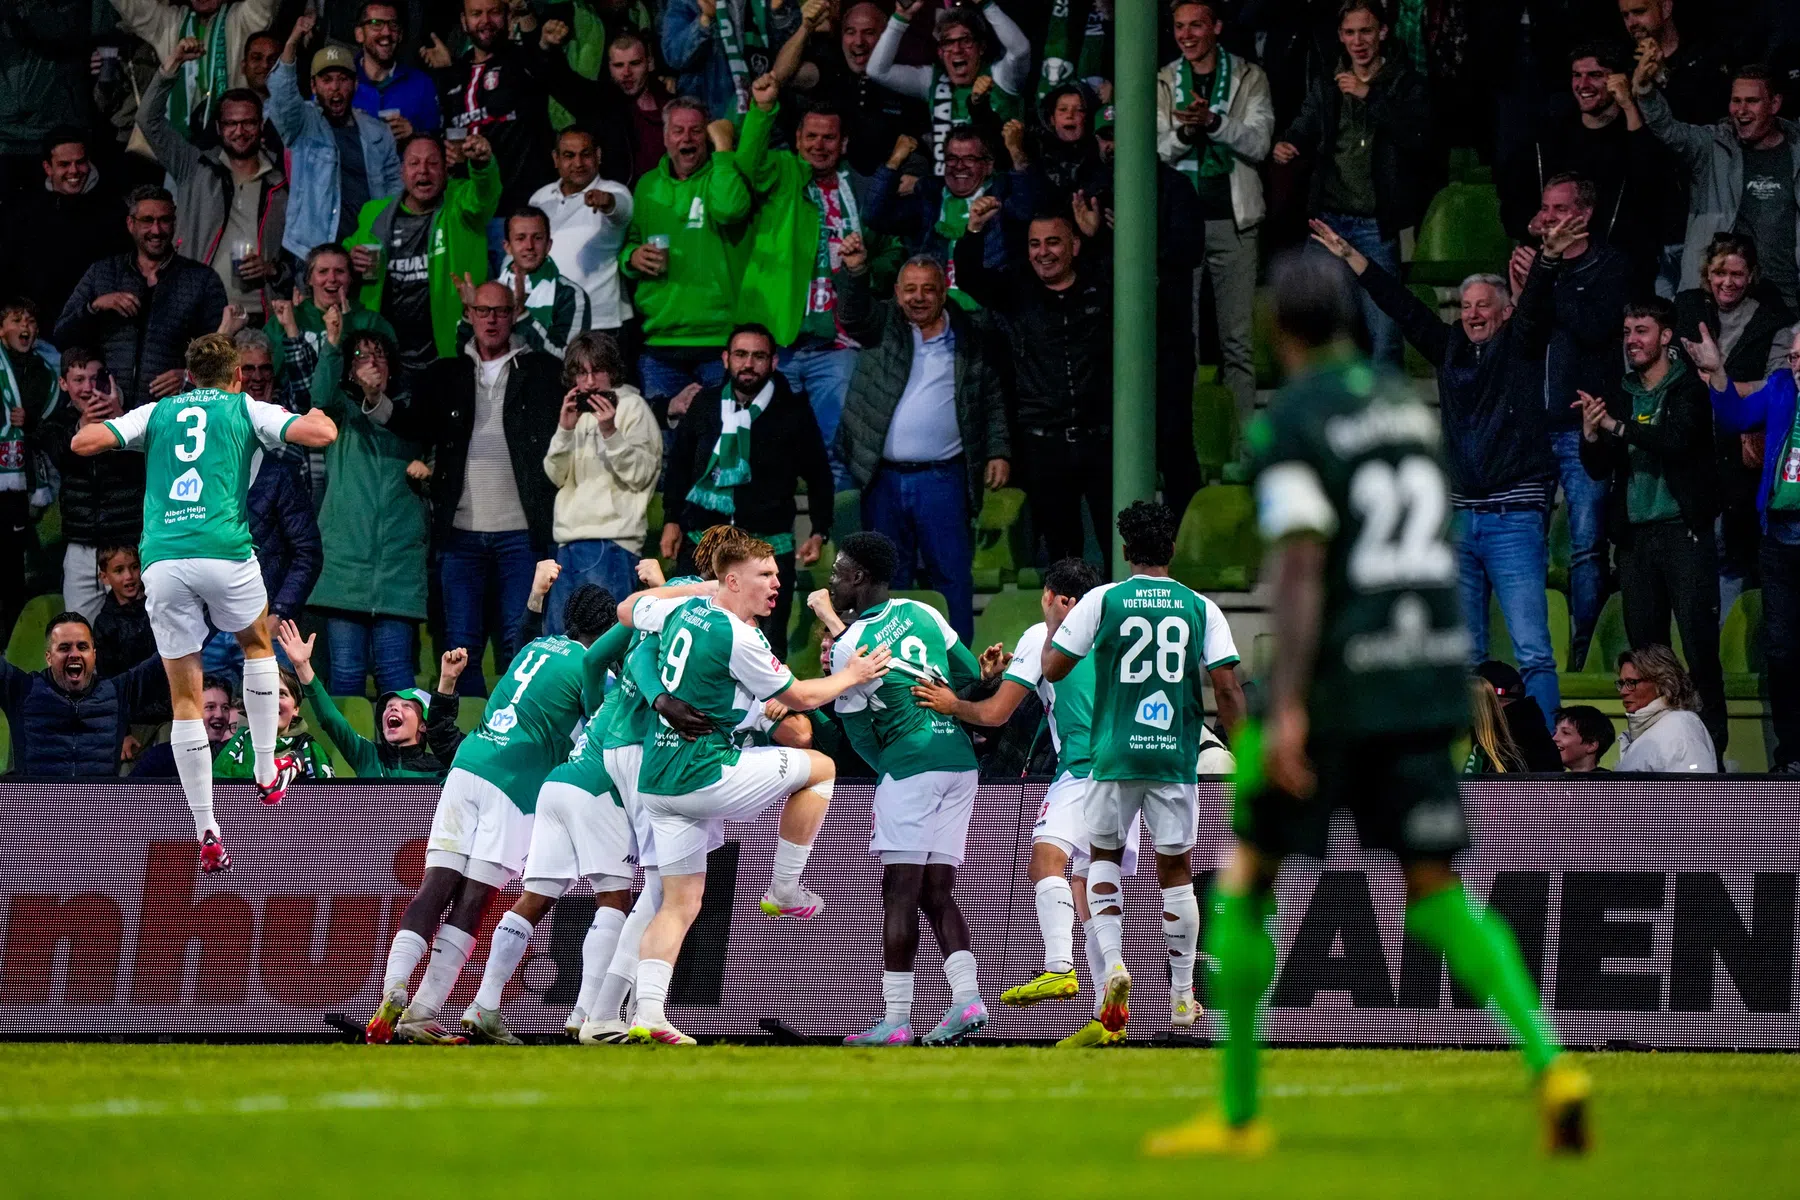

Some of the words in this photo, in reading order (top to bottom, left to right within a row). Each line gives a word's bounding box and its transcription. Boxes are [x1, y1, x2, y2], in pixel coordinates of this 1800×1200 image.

[175, 406, 207, 462] 3
[165, 508, 185, 517] Albert
[187, 505, 206, 514] Heijn
[190, 512, 206, 520] Poel
[1350, 455, 1455, 590] 22
[1123, 598, 1184, 609] VOETBALBOX.NL
[1136, 588, 1171, 598] MYSTERY
[874, 616, 900, 643] MYSTERY
[880, 617, 914, 650] BALBOX.NL
[661, 627, 694, 693] 9
[1120, 616, 1190, 684] 28
[510, 650, 551, 704] 4
[1130, 734, 1154, 742] Albert
[1157, 734, 1177, 743] Heijn
[1146, 742, 1159, 750] der
[1161, 742, 1177, 750] Poel
[1193, 868, 1796, 1014] AMEN
